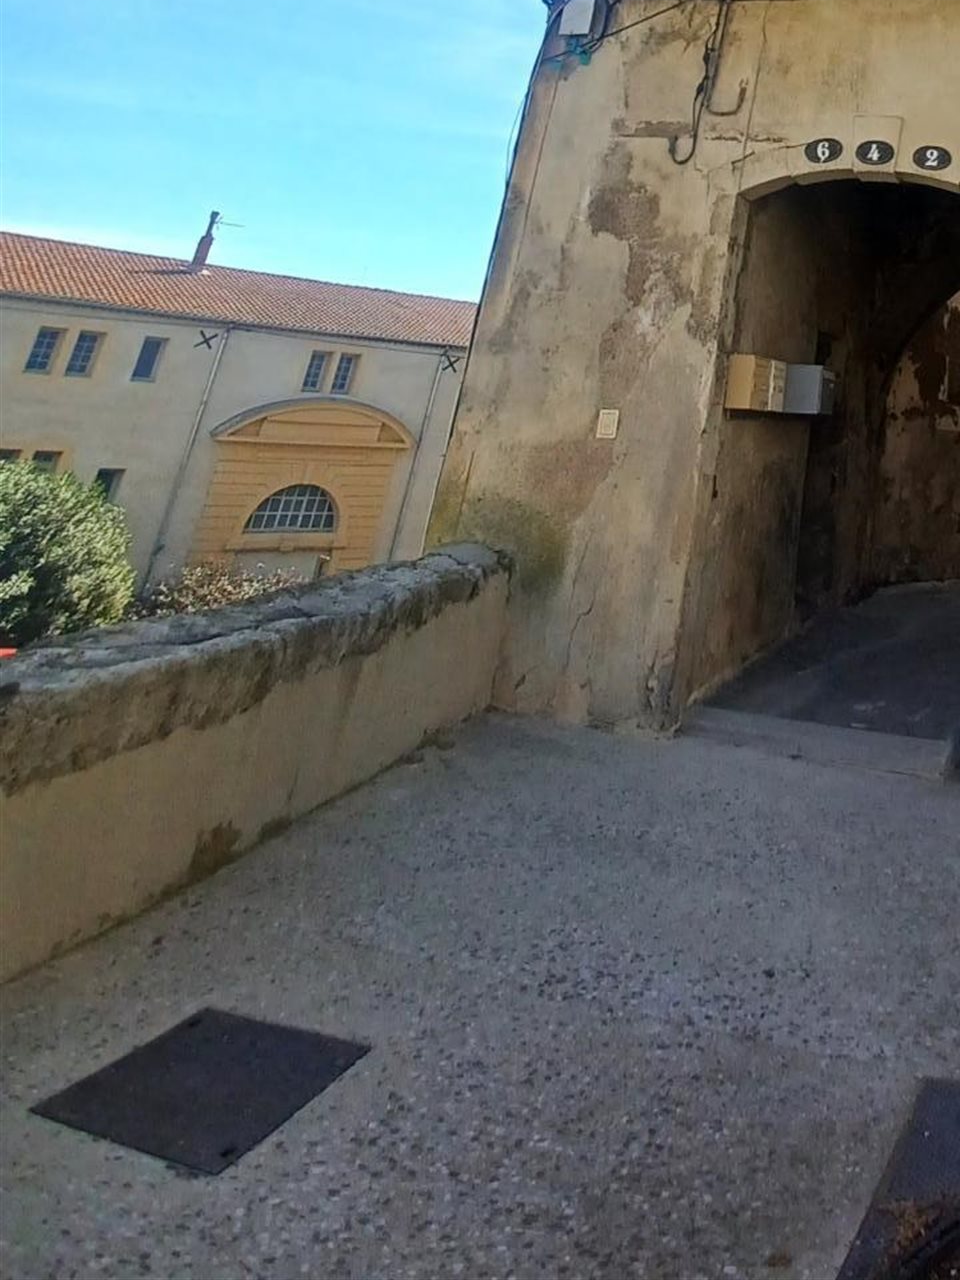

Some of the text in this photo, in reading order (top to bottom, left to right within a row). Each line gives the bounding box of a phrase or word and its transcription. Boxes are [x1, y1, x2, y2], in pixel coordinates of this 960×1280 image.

[816, 141, 830, 160] 6
[866, 143, 881, 161] 4
[925, 148, 938, 166] 2
